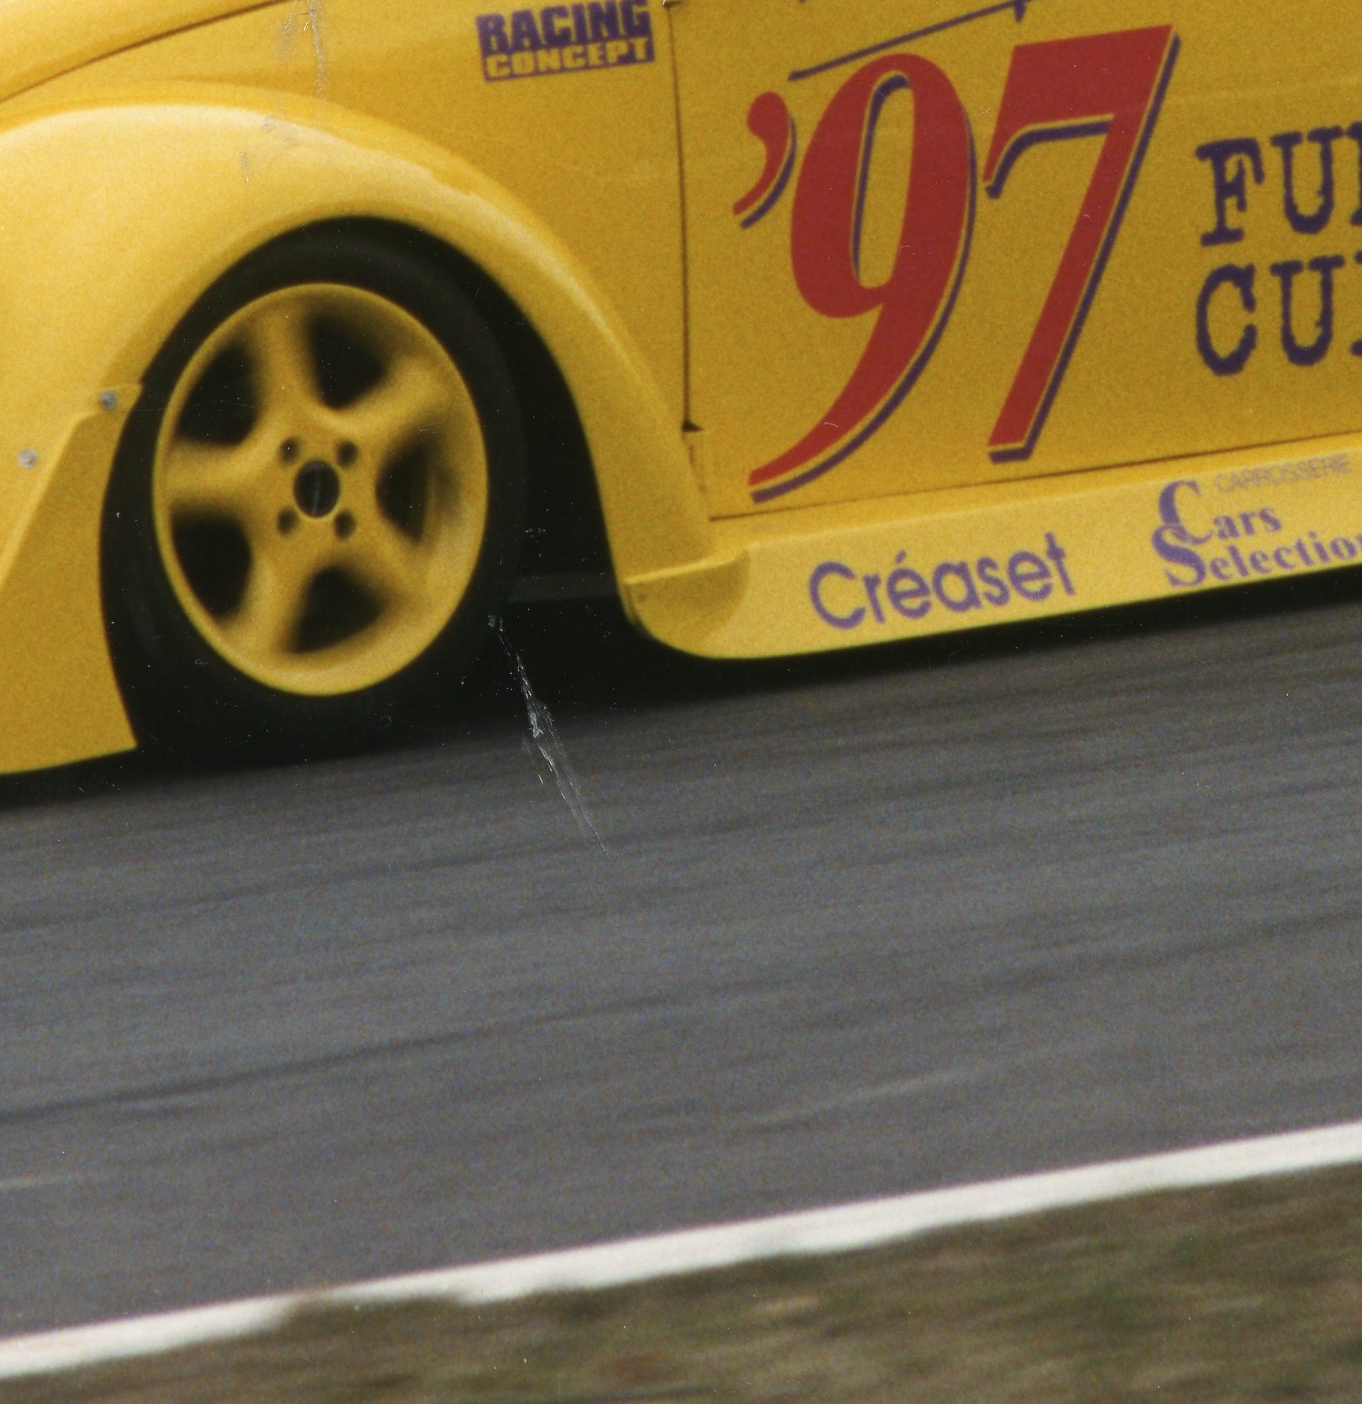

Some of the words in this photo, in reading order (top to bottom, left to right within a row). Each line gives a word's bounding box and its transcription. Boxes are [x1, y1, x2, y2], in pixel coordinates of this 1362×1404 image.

[485, 36, 650, 78] CONCEPT
[1158, 479, 1282, 546] Cars
[809, 531, 1077, 630] Créaset
